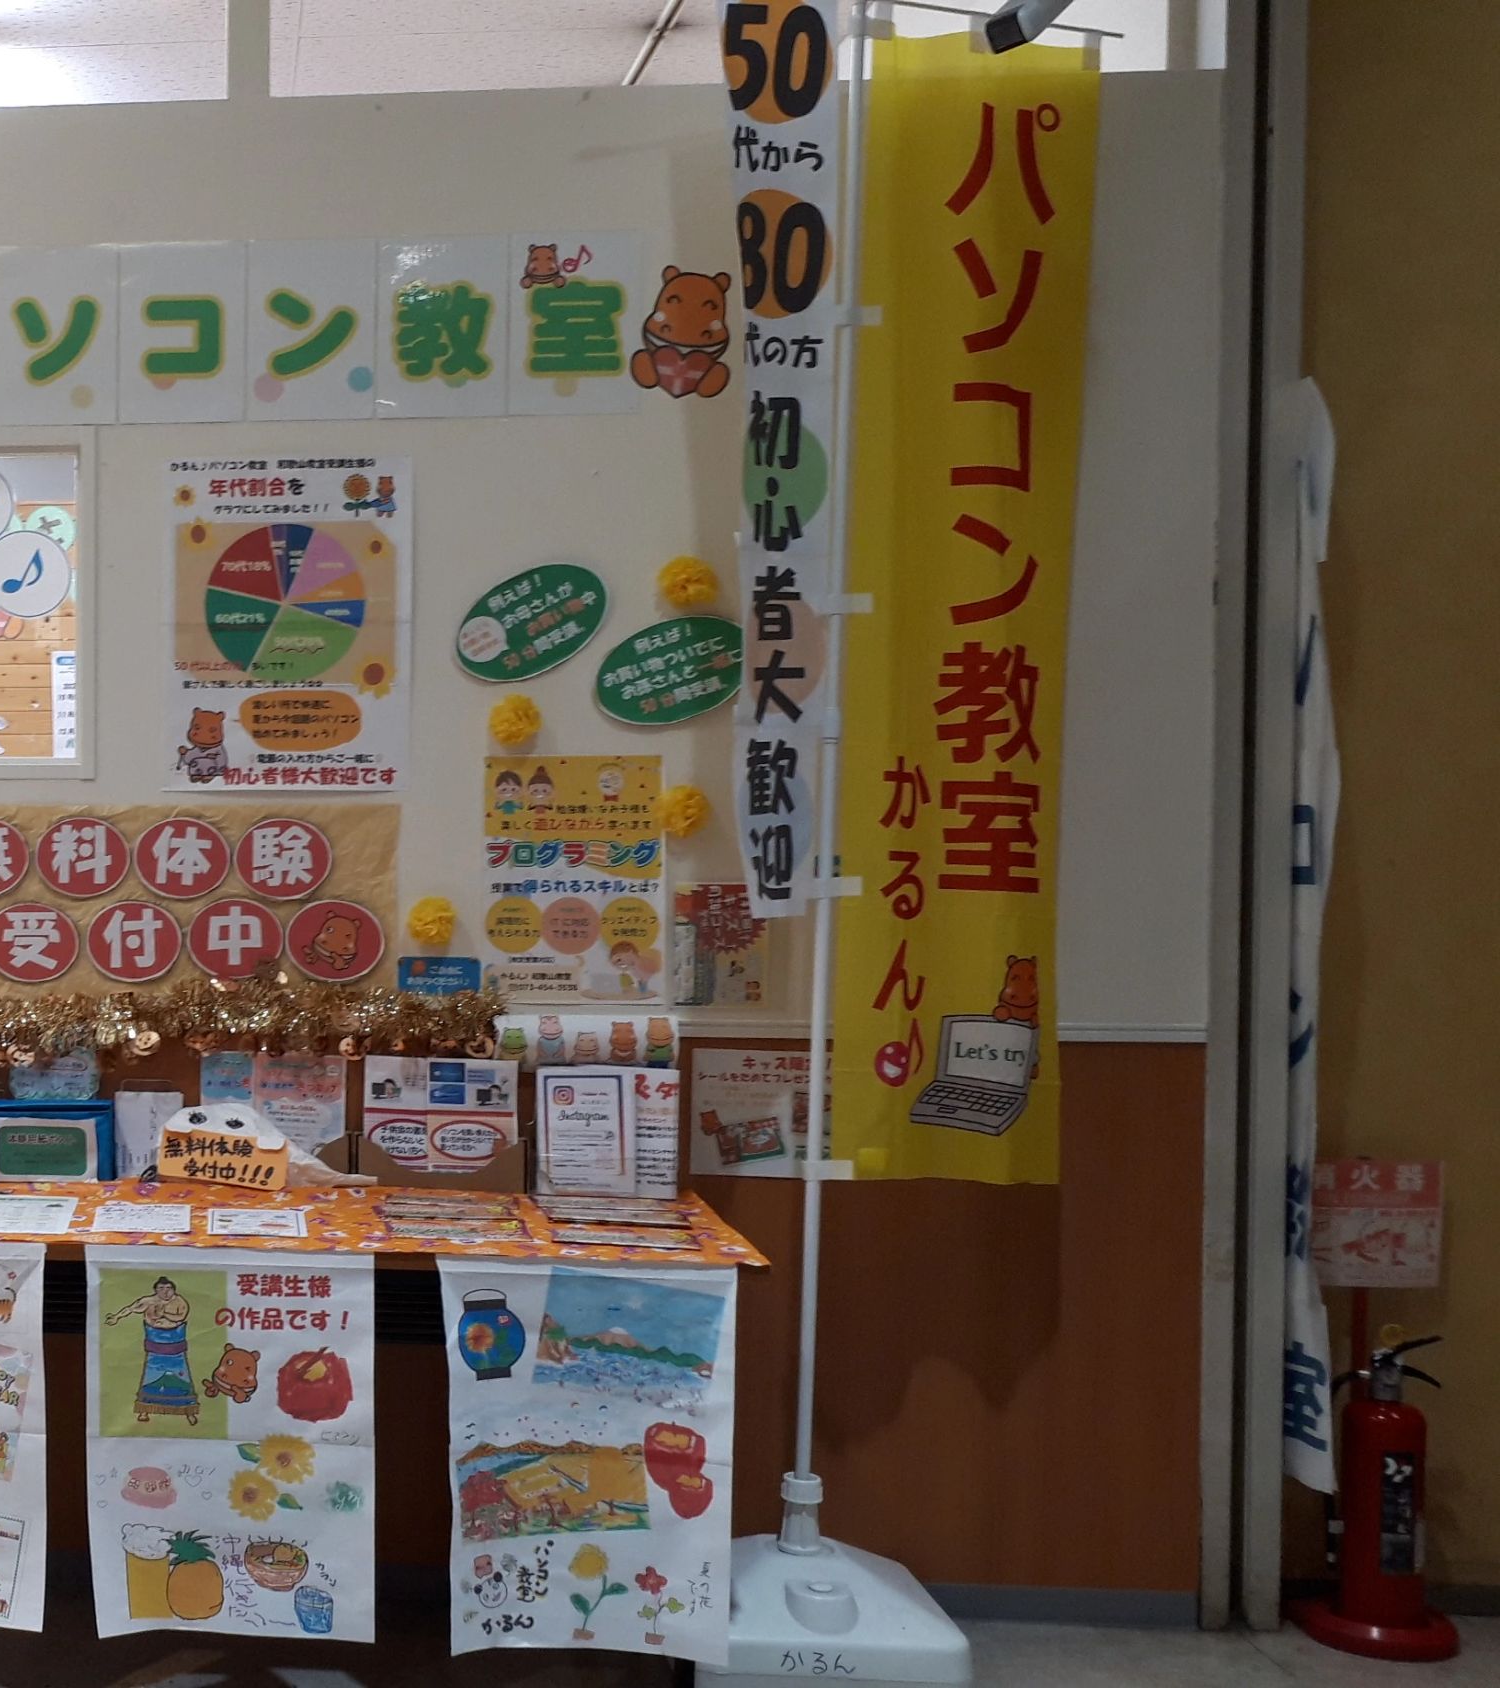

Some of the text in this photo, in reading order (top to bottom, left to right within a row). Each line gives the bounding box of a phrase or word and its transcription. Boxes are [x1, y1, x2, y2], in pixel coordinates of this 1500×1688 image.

[724, 3, 827, 118] 50
[733, 124, 824, 171] 代から
[208, 477, 305, 498] 年代割合を
[933, 102, 1062, 893] パソコン教室
[747, 391, 805, 899] 初心者大歓迎
[222, 766, 397, 786] 初心者様大歓迎です
[486, 839, 661, 868] プログラミング
[3, 906, 263, 969] 受付中
[954, 1042, 1026, 1067] Let's try
[558, 1109, 610, 1131] Instagram
[236, 1273, 332, 1299] 受講生様
[214, 1309, 351, 1333] の作品です!
[481, 1613, 535, 1636] かるん
[780, 1650, 856, 1675] かるん
